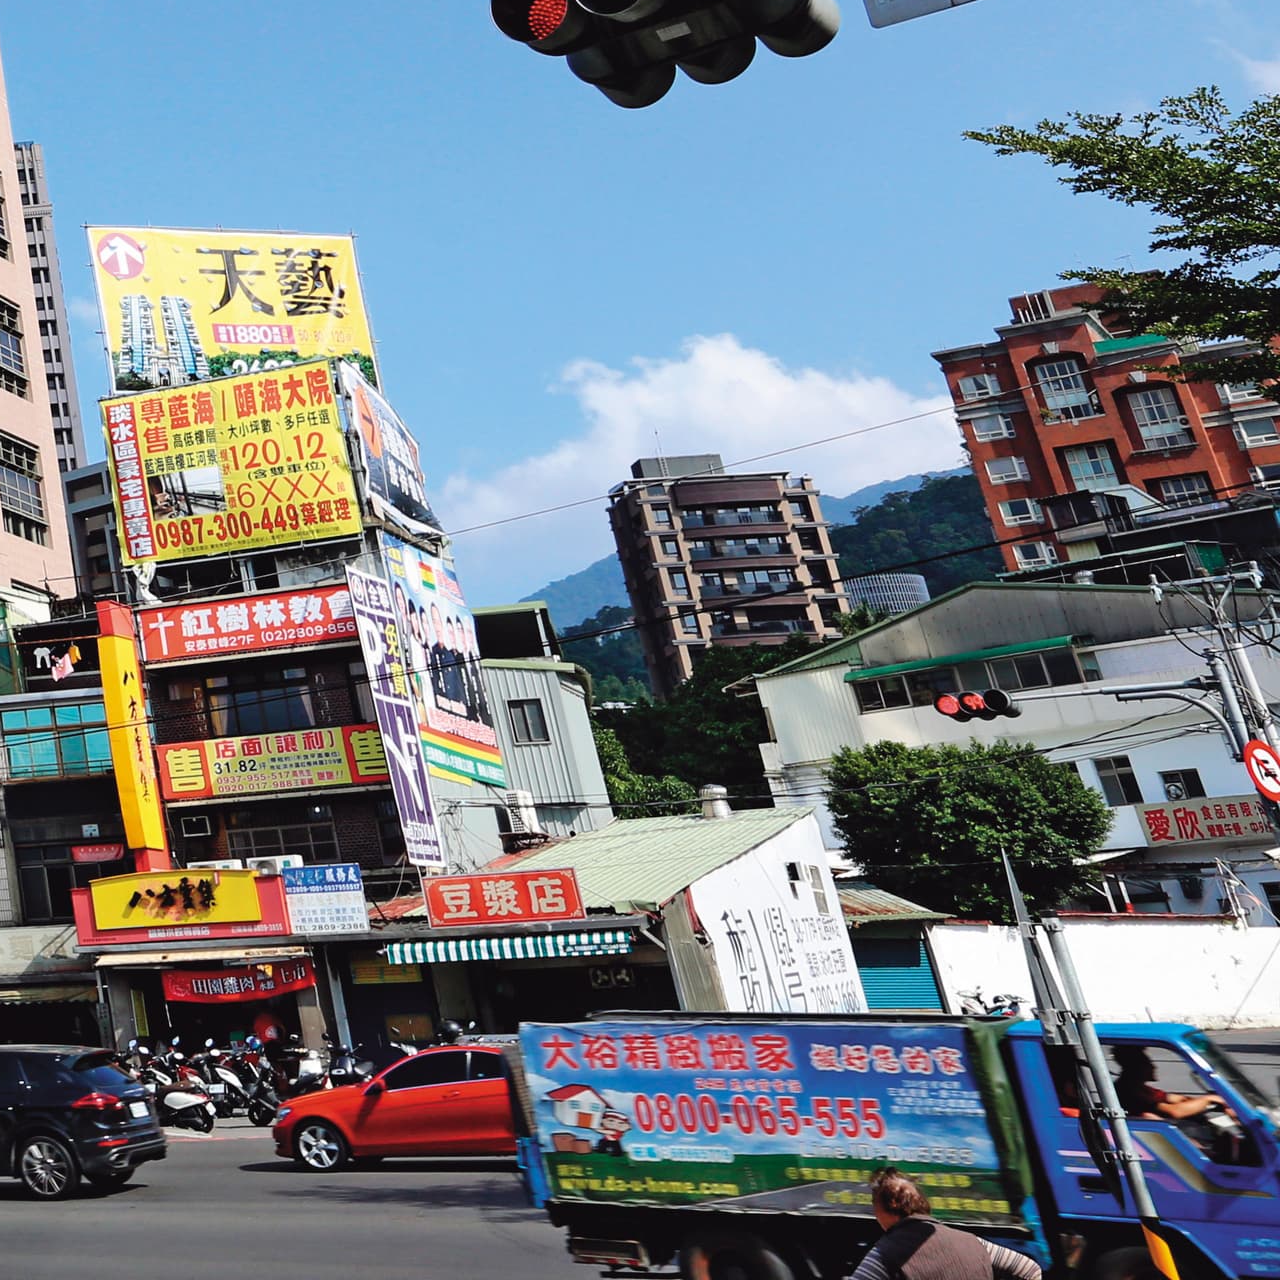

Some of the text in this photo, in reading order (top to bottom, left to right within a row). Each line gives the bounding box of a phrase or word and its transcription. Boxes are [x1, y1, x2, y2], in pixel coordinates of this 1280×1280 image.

[196, 247, 346, 318] 天藝
[140, 398, 168, 453] 專售
[228, 432, 327, 471] 120.12
[237, 471, 335, 508] 6XXX
[155, 503, 299, 549] 0987-300-449
[300, 497, 352, 526] 葉經理
[181, 588, 356, 637] 紅樹林教會
[384, 623, 408, 698] 免費
[164, 748, 207, 793] 售
[214, 759, 257, 775] 31.82
[1144, 807, 1204, 842] 愛欣
[439, 877, 567, 919] 豆漿店
[541, 1033, 795, 1072] 大裕精緻搬家
[634, 1093, 885, 1139] 0800-065-555
